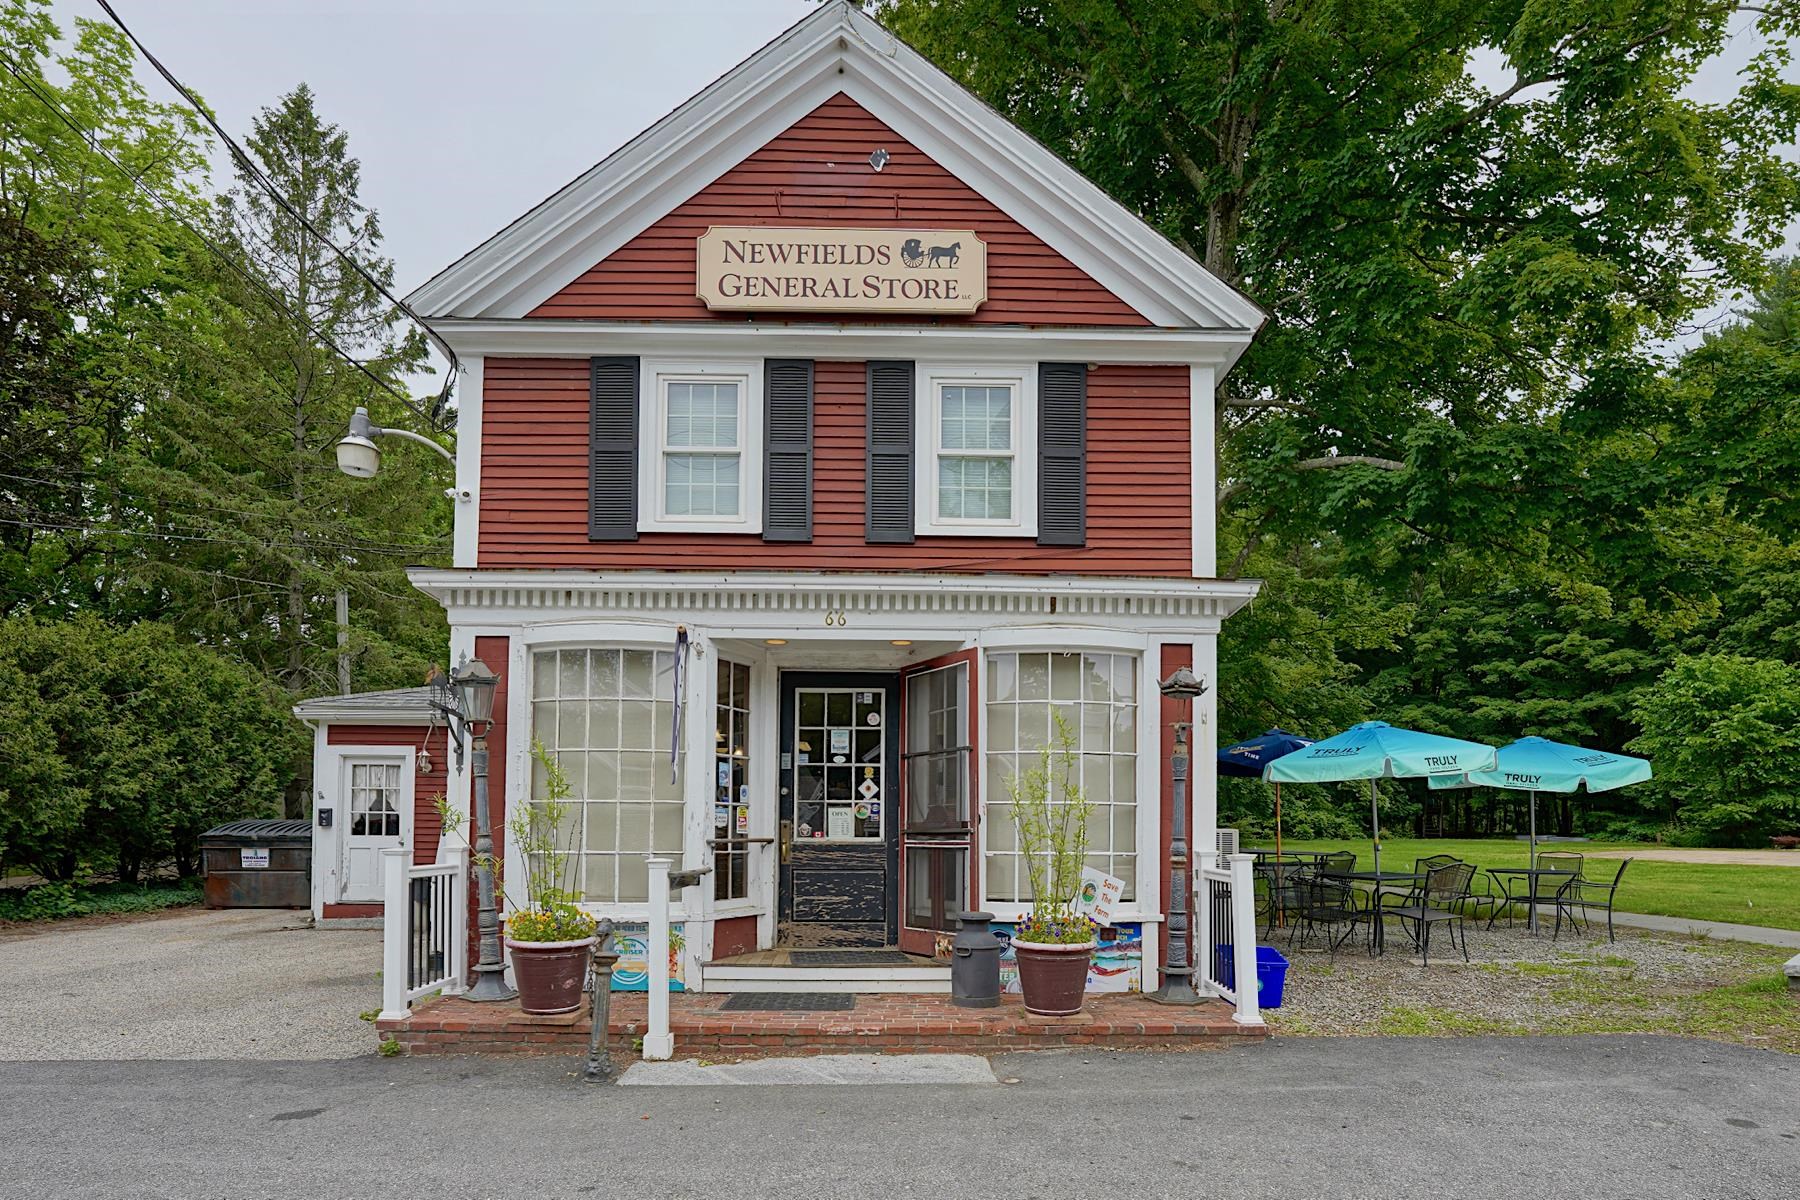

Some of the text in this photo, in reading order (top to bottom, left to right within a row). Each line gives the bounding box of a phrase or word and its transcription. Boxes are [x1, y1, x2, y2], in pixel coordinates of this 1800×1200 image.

[722, 239, 891, 266] NEWFIELDS
[718, 273, 858, 299] GENERAL
[862, 275, 959, 300] STORE
[825, 610, 847, 626] 66
[1313, 746, 1367, 755] TRULY
[1424, 755, 1458, 766] TRULY
[1504, 773, 1541, 783] TRULY
[1103, 878, 1119, 893] Save
[1101, 892, 1112, 904] The
[1094, 904, 1110, 919] Farm
